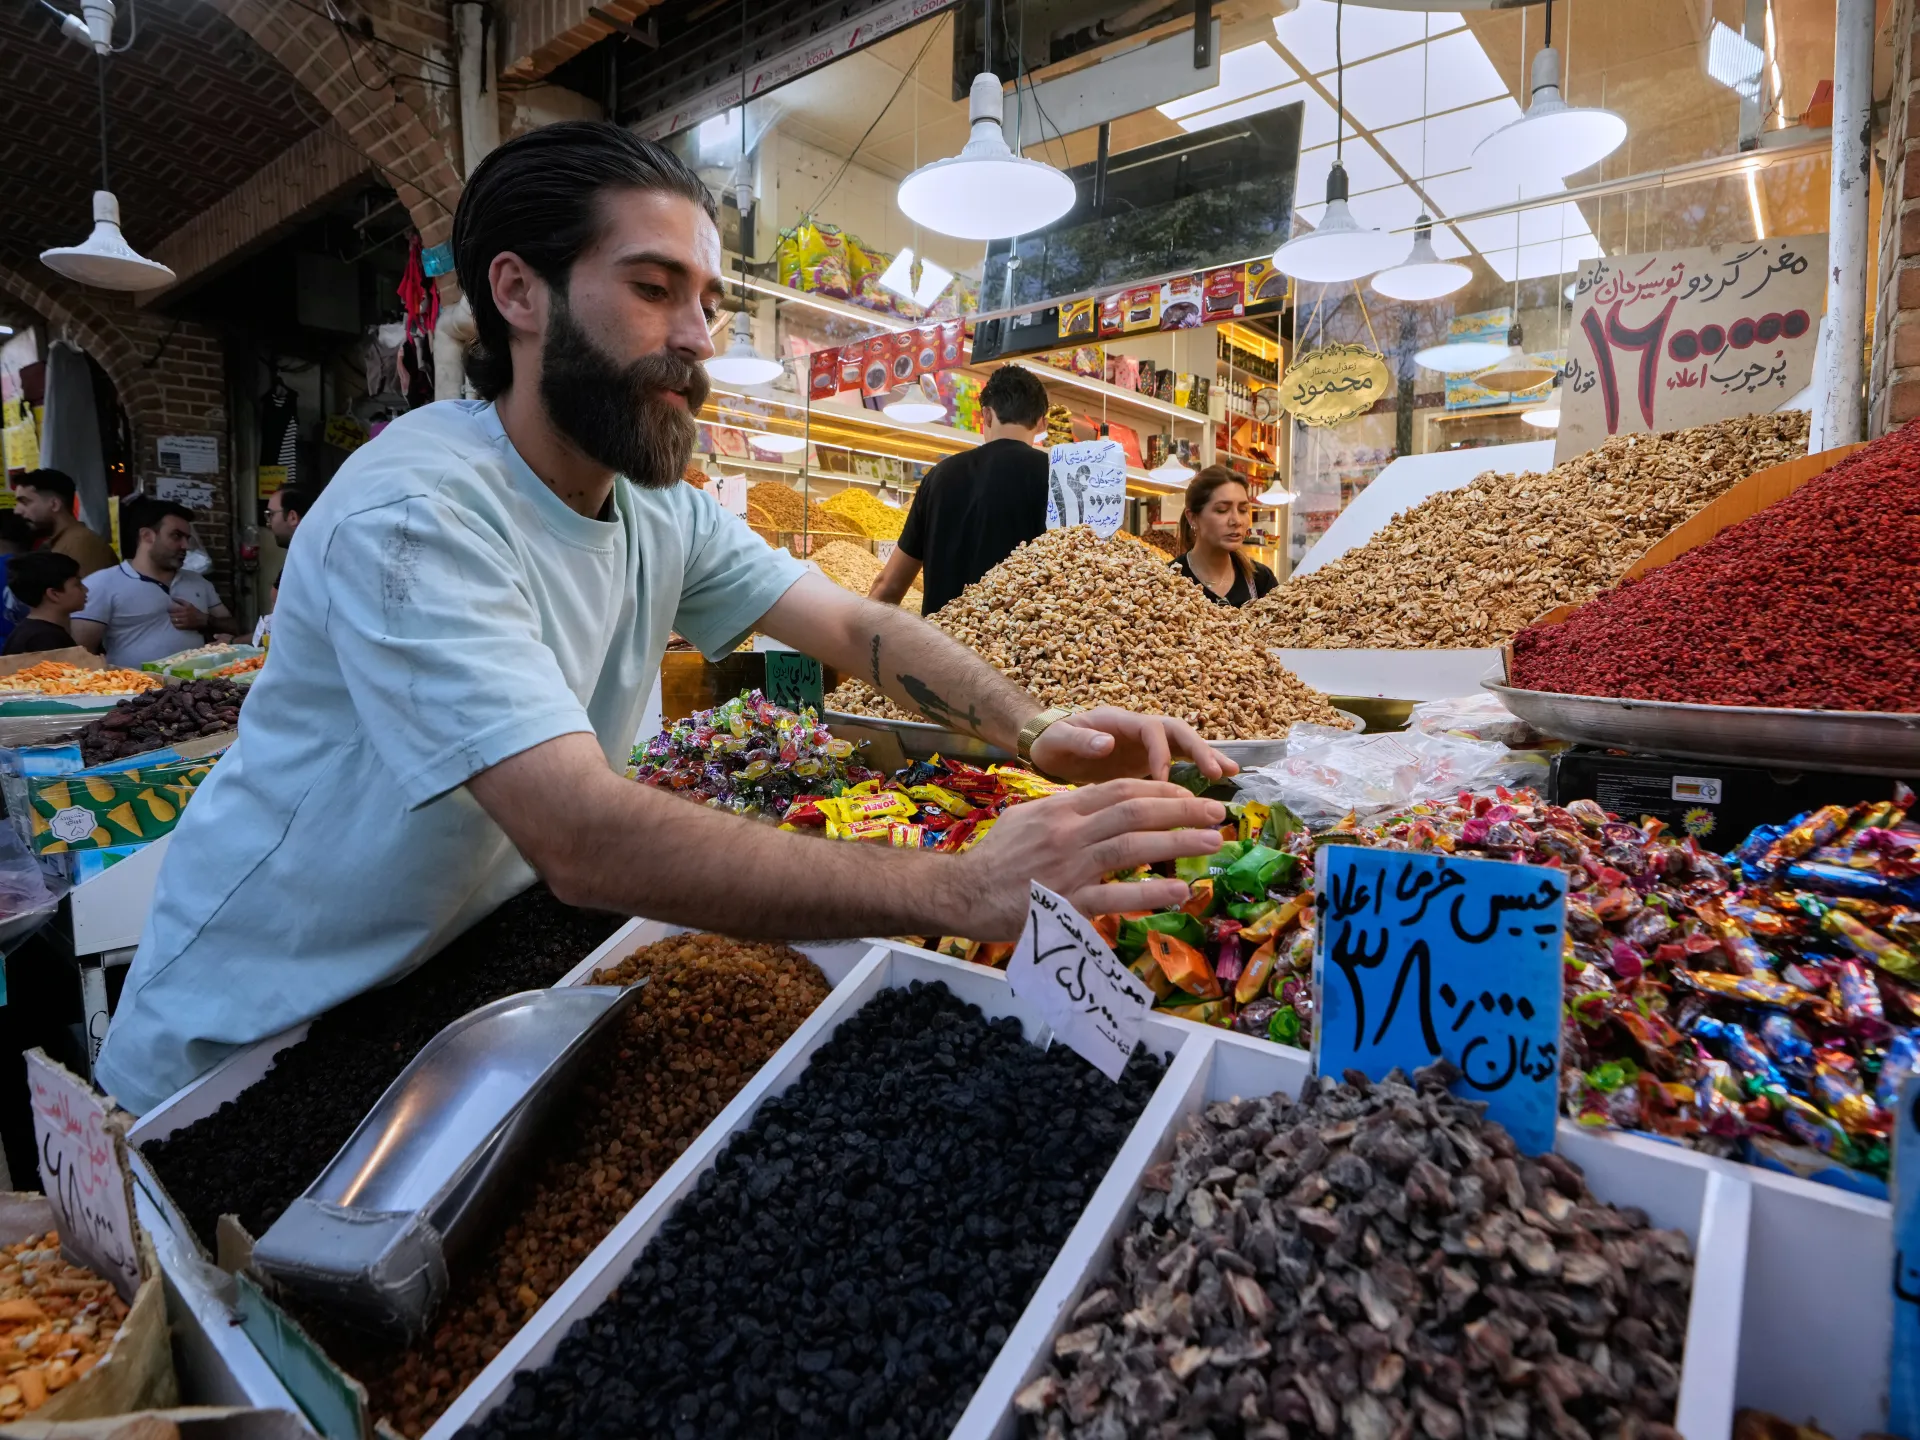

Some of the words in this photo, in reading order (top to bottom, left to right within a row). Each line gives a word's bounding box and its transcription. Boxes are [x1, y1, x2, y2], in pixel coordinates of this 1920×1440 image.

[806, 48, 834, 67] KODIA
[1576, 260, 1609, 295] تازه
[1680, 245, 1763, 302] گردو
[1741, 243, 1809, 299] مغز
[1310, 366, 1331, 378] ممتاز
[1332, 362, 1357, 375] زعفران
[1564, 358, 1596, 394] تومان
[1396, 857, 1467, 927] خرما
[1056, 913, 1083, 943] هسته
[1085, 941, 1103, 964] بی
[1093, 959, 1146, 1006] مویز
[1096, 1024, 1130, 1056] تومان
[1461, 1035, 1557, 1092] تومان
